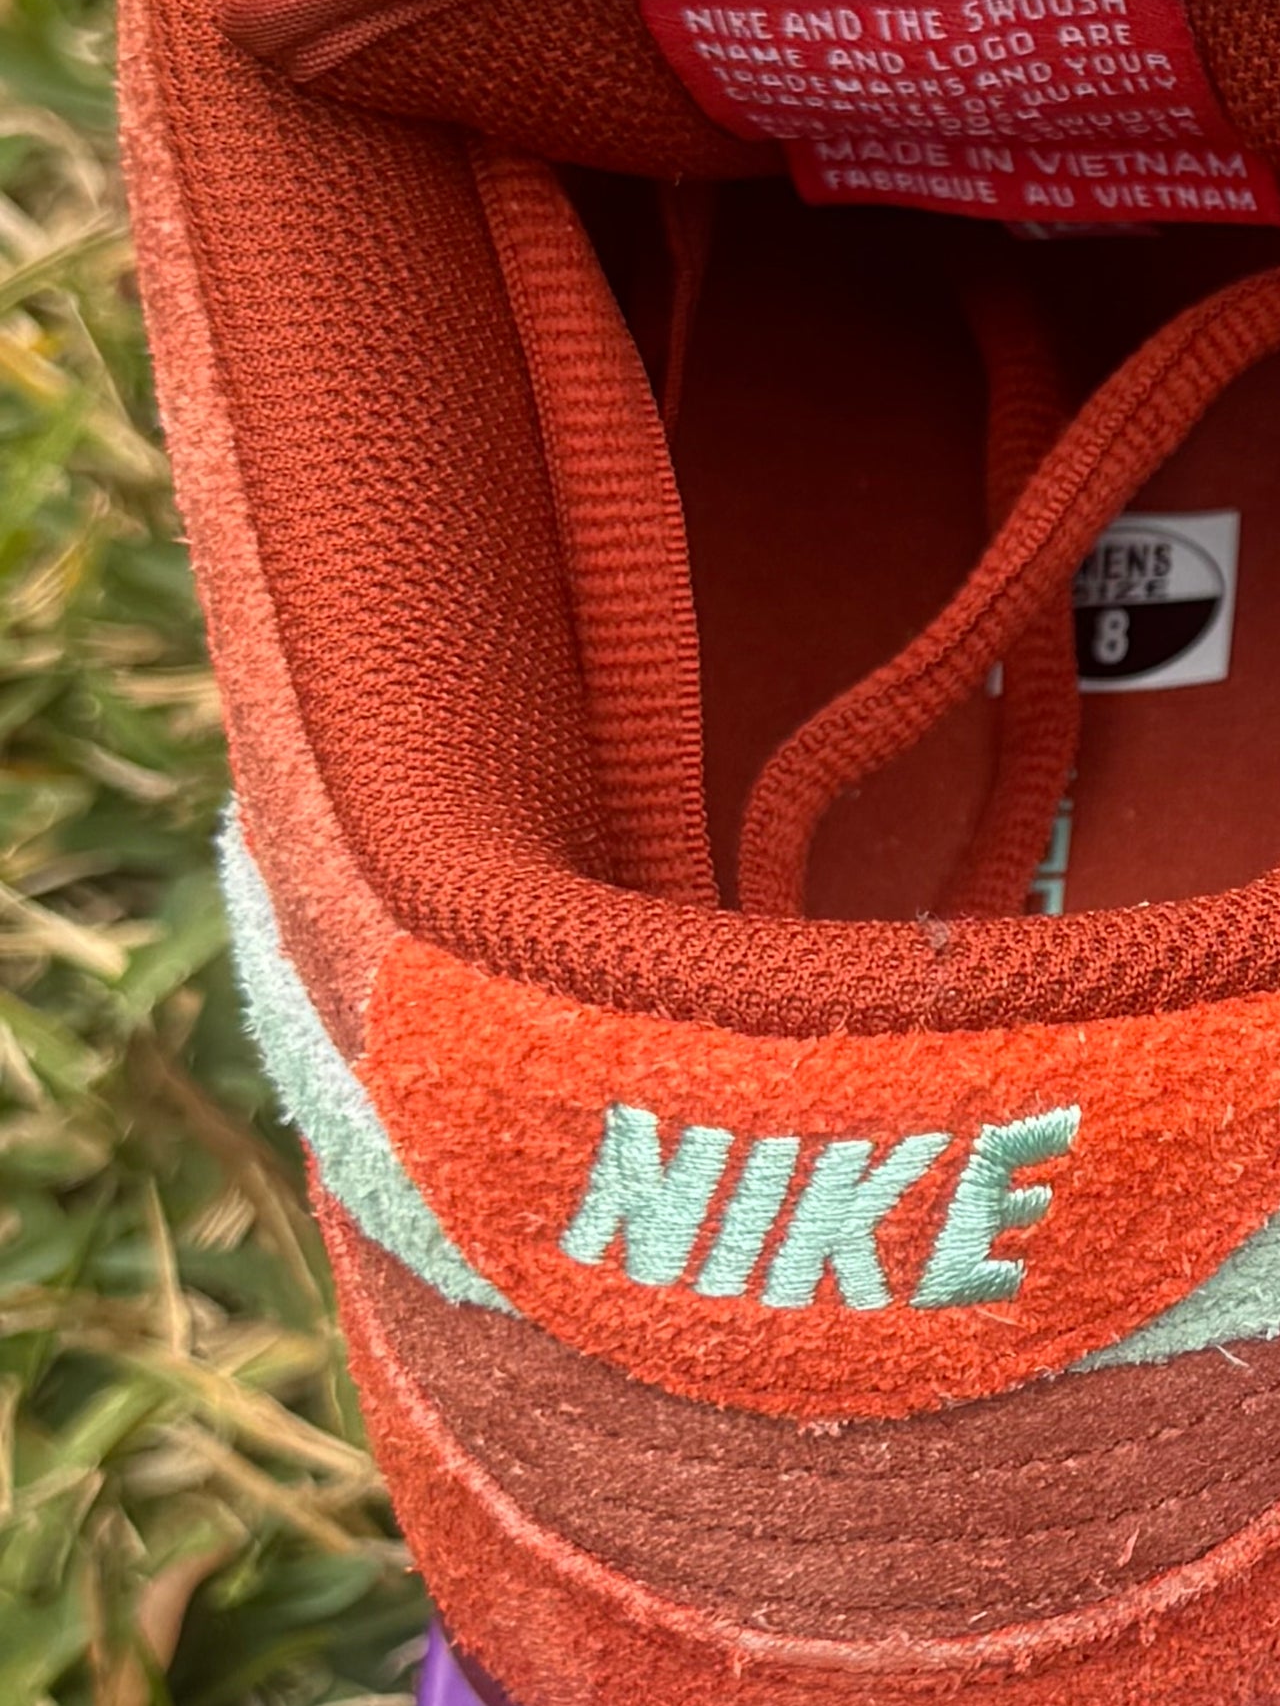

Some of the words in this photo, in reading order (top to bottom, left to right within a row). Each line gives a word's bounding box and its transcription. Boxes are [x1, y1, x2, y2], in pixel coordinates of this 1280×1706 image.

[683, 7, 774, 40] NIKE
[781, 8, 862, 42] AND
[873, 7, 948, 42] THE
[696, 41, 805, 70] NAME
[827, 48, 905, 75] AND
[926, 31, 1036, 72] LOGO
[1056, 23, 1136, 48] ARE
[975, 61, 1053, 92] AND
[1063, 53, 1172, 77] YOUR
[814, 140, 952, 168] MADE
[967, 146, 1015, 174] IN
[1028, 149, 1249, 179] VIETNAM
[822, 167, 998, 204] FABRIQUE
[1024, 181, 1075, 208] AU
[1091, 183, 1258, 212] VIETNAM
[1094, 607, 1130, 665] 8
[558, 1101, 1080, 1311] NIKE
